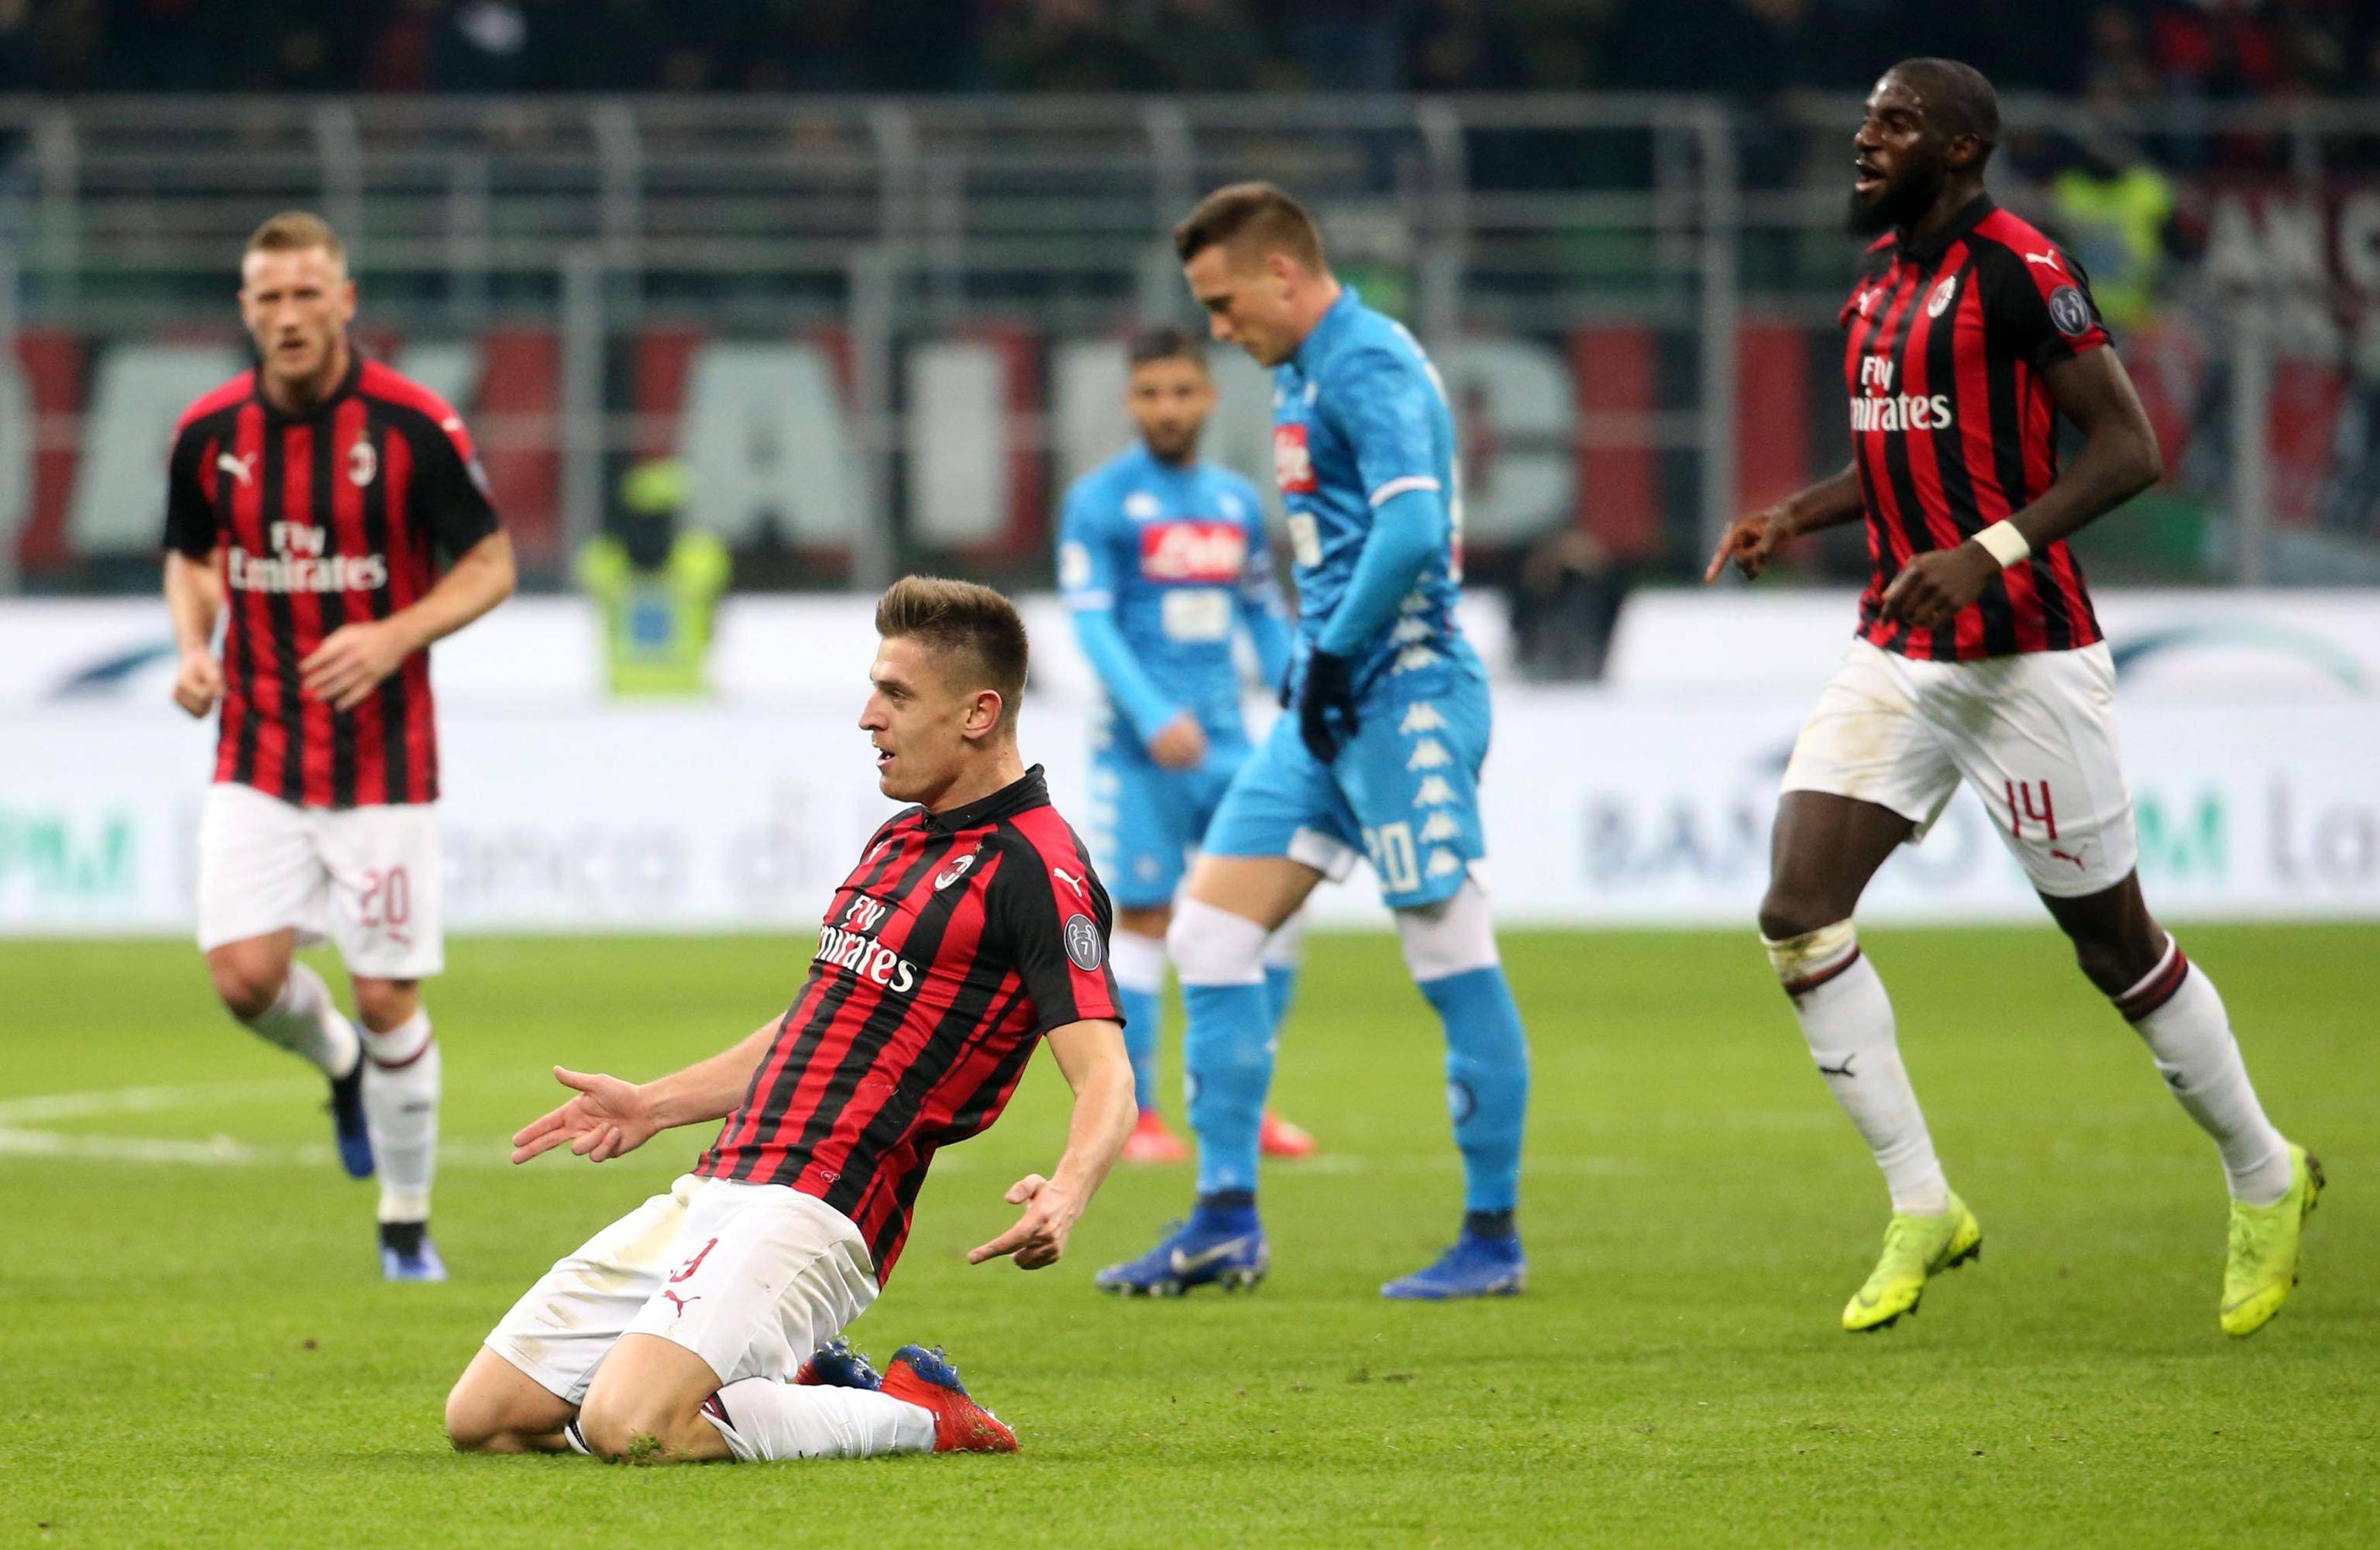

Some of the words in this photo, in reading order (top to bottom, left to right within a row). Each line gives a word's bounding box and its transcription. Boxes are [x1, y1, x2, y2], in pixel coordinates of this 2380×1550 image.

[1861, 356, 1893, 390] Fly
[1850, 387, 1952, 431] mirates
[270, 520, 326, 558] Fly
[229, 545, 387, 593] Emirates
[2004, 778, 2057, 841] 14
[359, 865, 409, 928] 20
[846, 895, 886, 931] Fly
[816, 923, 917, 992] mirates
[1080, 940, 1089, 956] 7
